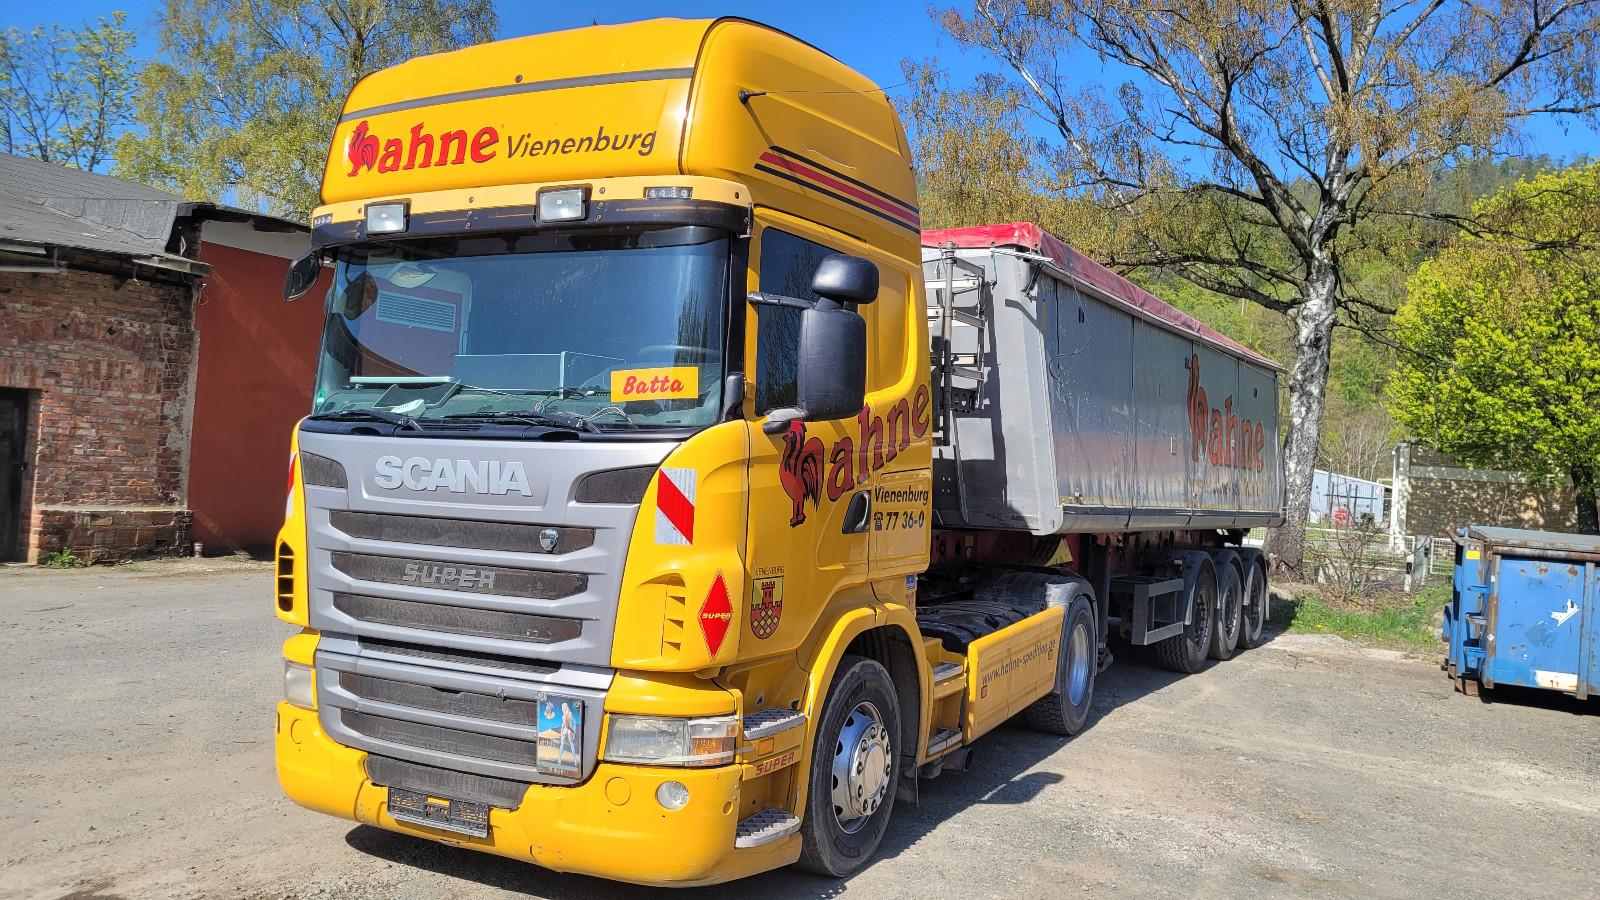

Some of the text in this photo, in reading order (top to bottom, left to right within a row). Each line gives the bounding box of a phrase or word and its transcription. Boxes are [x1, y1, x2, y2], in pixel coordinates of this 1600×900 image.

[507, 126, 657, 158] Vienenburg
[623, 375, 684, 396] Batta
[374, 455, 533, 497] SCANIA
[874, 485, 929, 506] Vienenburg
[886, 510, 925, 530] 77 36-0
[402, 563, 496, 589] SUPER
[756, 752, 794, 776] SUPER
